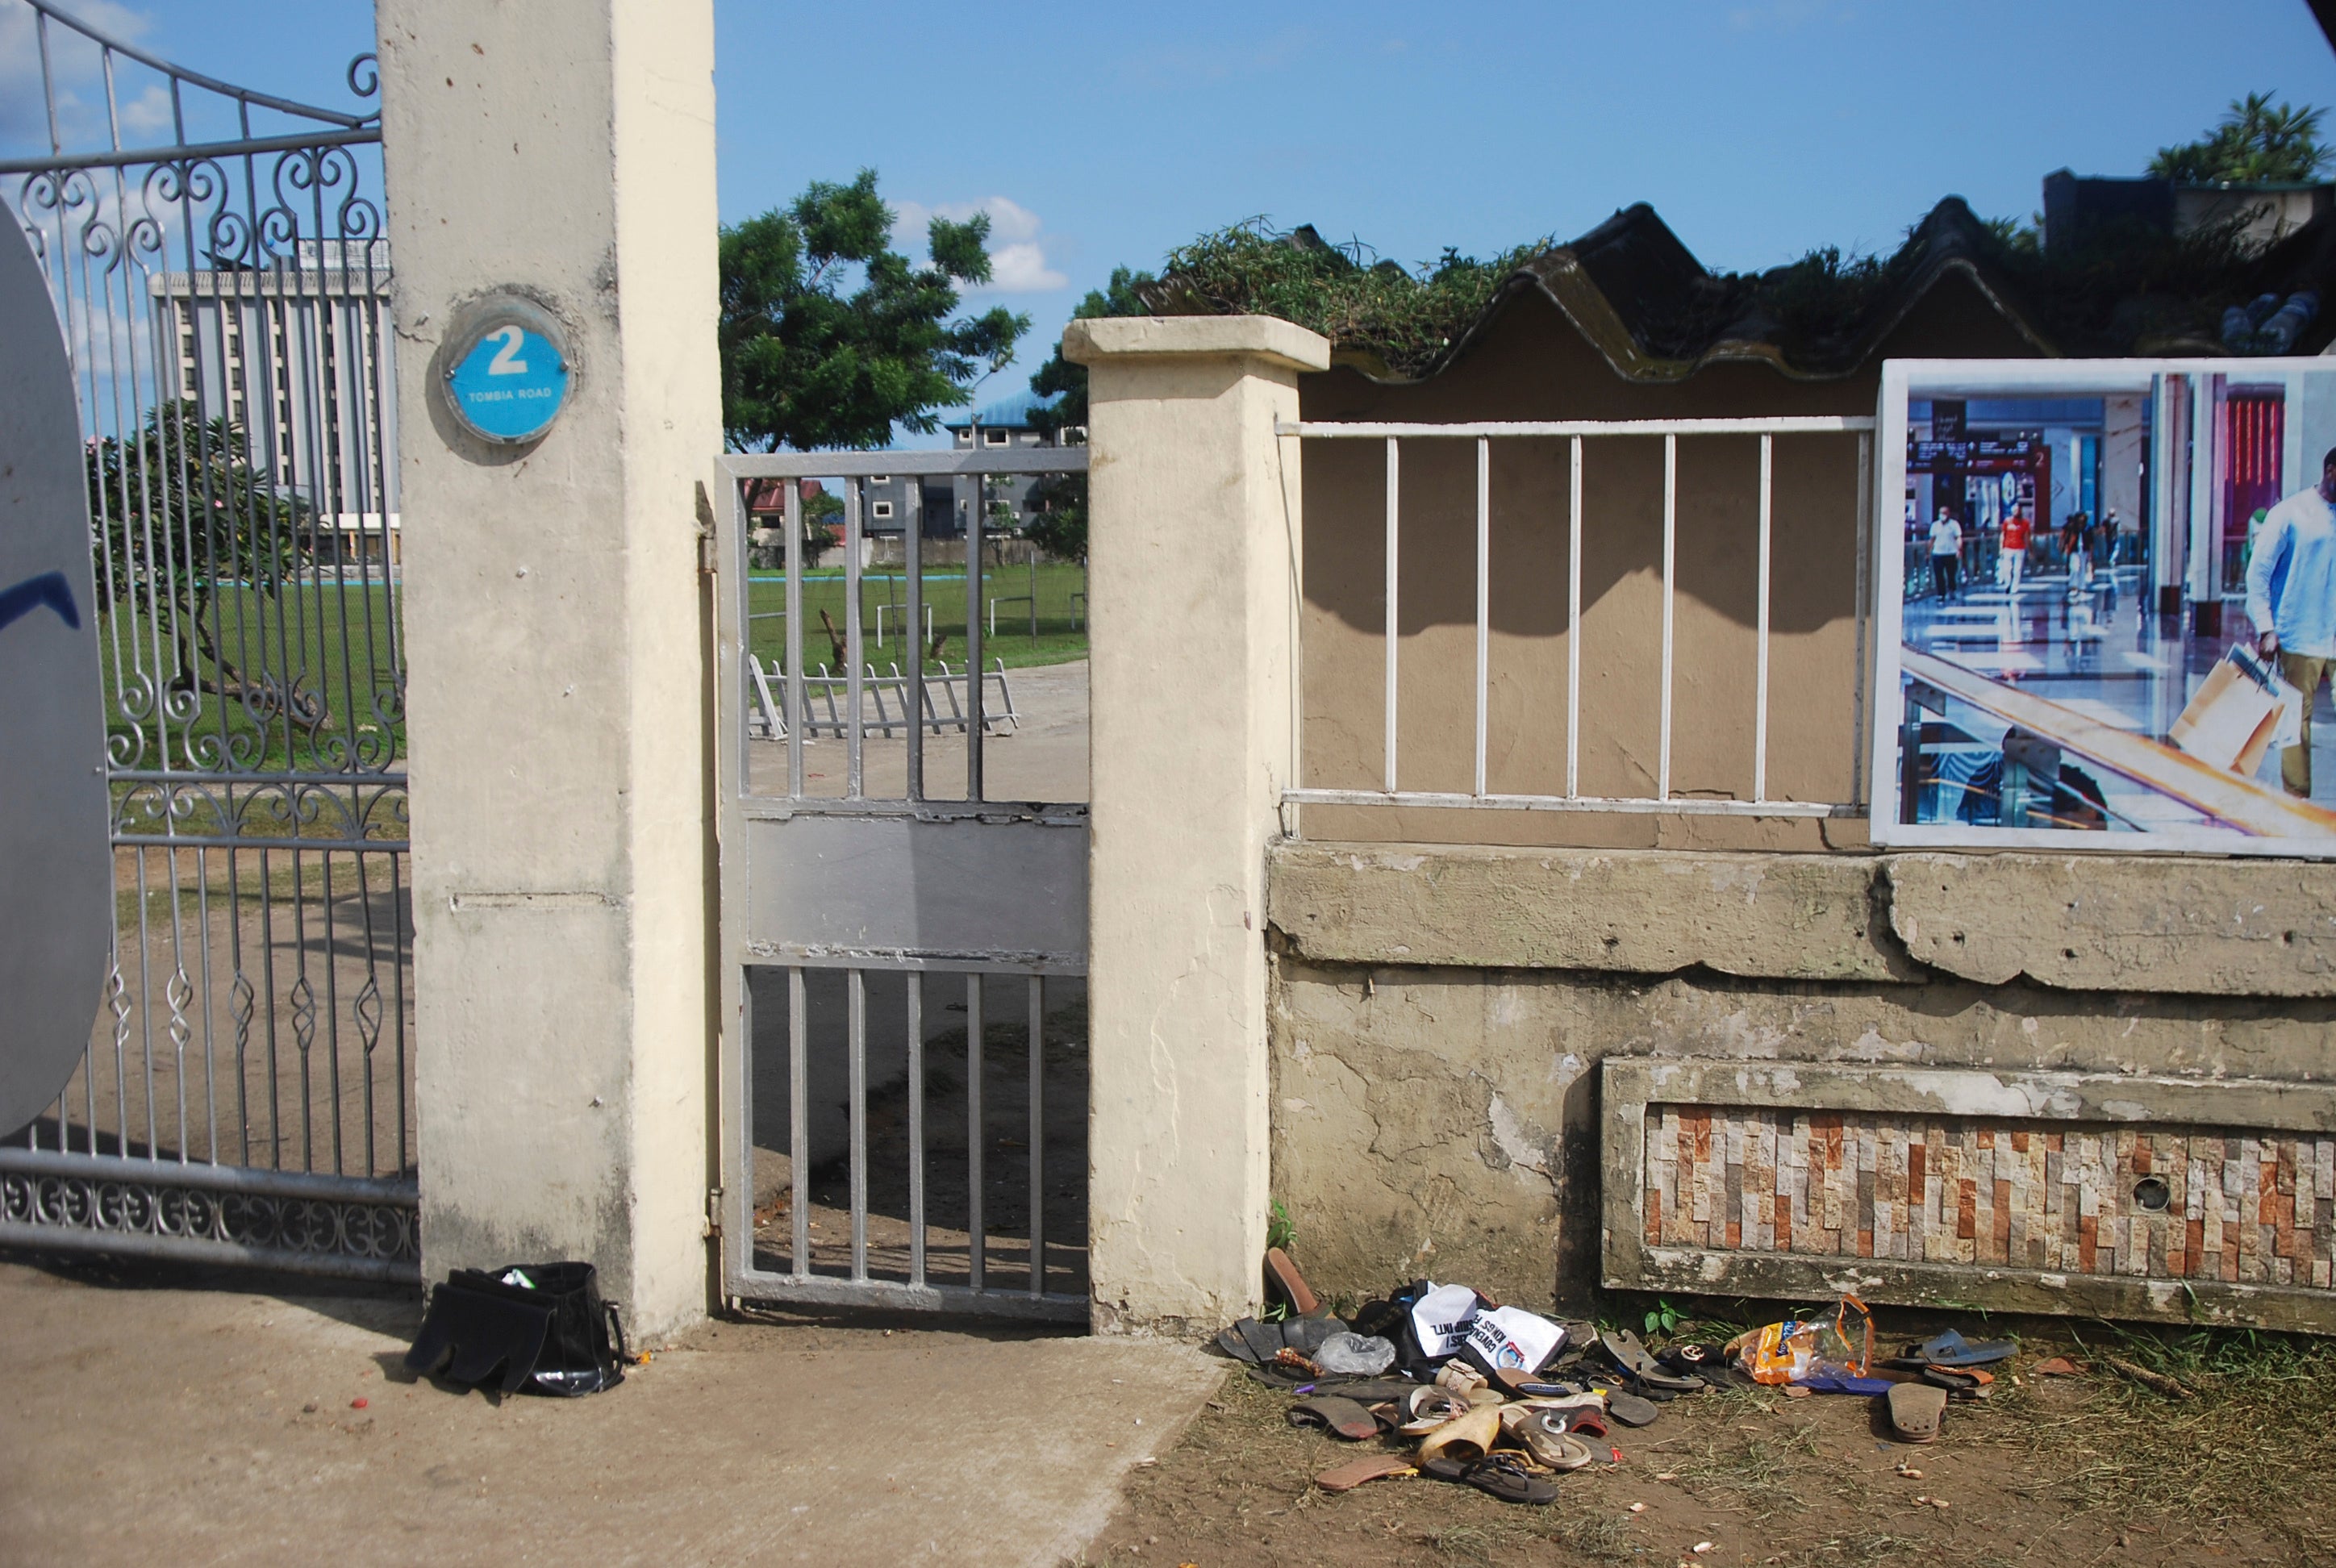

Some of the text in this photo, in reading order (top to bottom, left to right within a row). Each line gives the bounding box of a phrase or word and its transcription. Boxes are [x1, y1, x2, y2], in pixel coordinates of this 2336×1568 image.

[486, 325, 528, 375] 2
[469, 387, 552, 402] TOMBIA ROAD
[2034, 451, 2045, 467] 2
